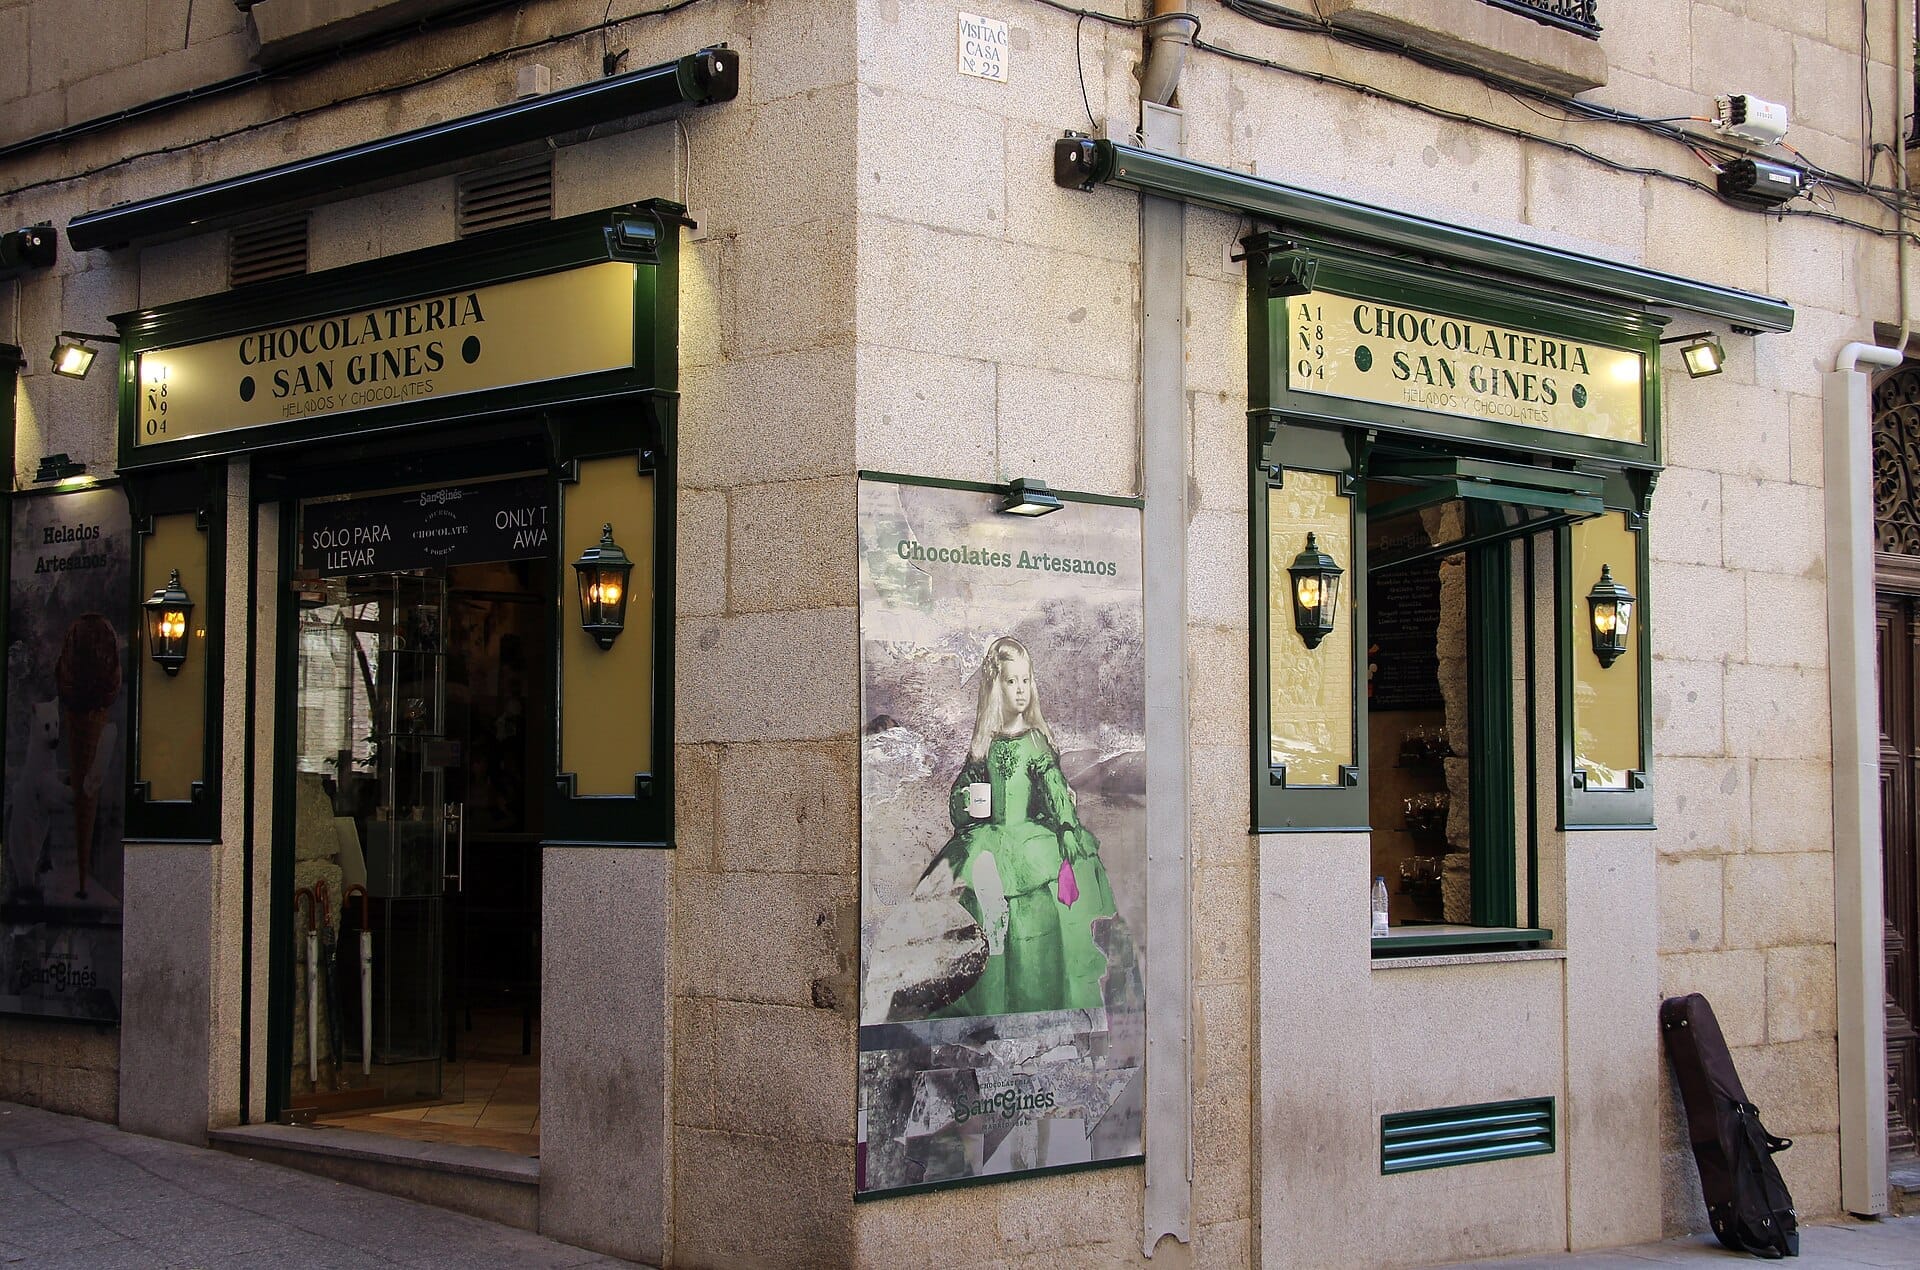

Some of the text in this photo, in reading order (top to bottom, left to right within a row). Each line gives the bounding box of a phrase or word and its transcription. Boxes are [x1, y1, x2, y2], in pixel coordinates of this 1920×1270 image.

[966, 40, 1000, 61] CASA
[980, 61, 1000, 78] 22
[239, 292, 486, 366] CHOCOLATERIA
[1353, 304, 1591, 375] CHOCOLATERIA
[272, 340, 445, 398] SAN GINES
[1391, 351, 1558, 406] SAN GINES
[282, 379, 434, 418] HELADOS Y CHOCOLATES
[1403, 387, 1550, 424] HELADOS Y CHOCOLATES
[495, 507, 536, 530] ONLY
[43, 523, 100, 544] Helados
[312, 524, 391, 550] SÓLO PARA
[412, 525, 469, 539] CHOCOLATE
[34, 555, 107, 574] Artesanos
[327, 548, 375, 570] LLEVAR
[897, 539, 1117, 576] Chocolates Artesanos
